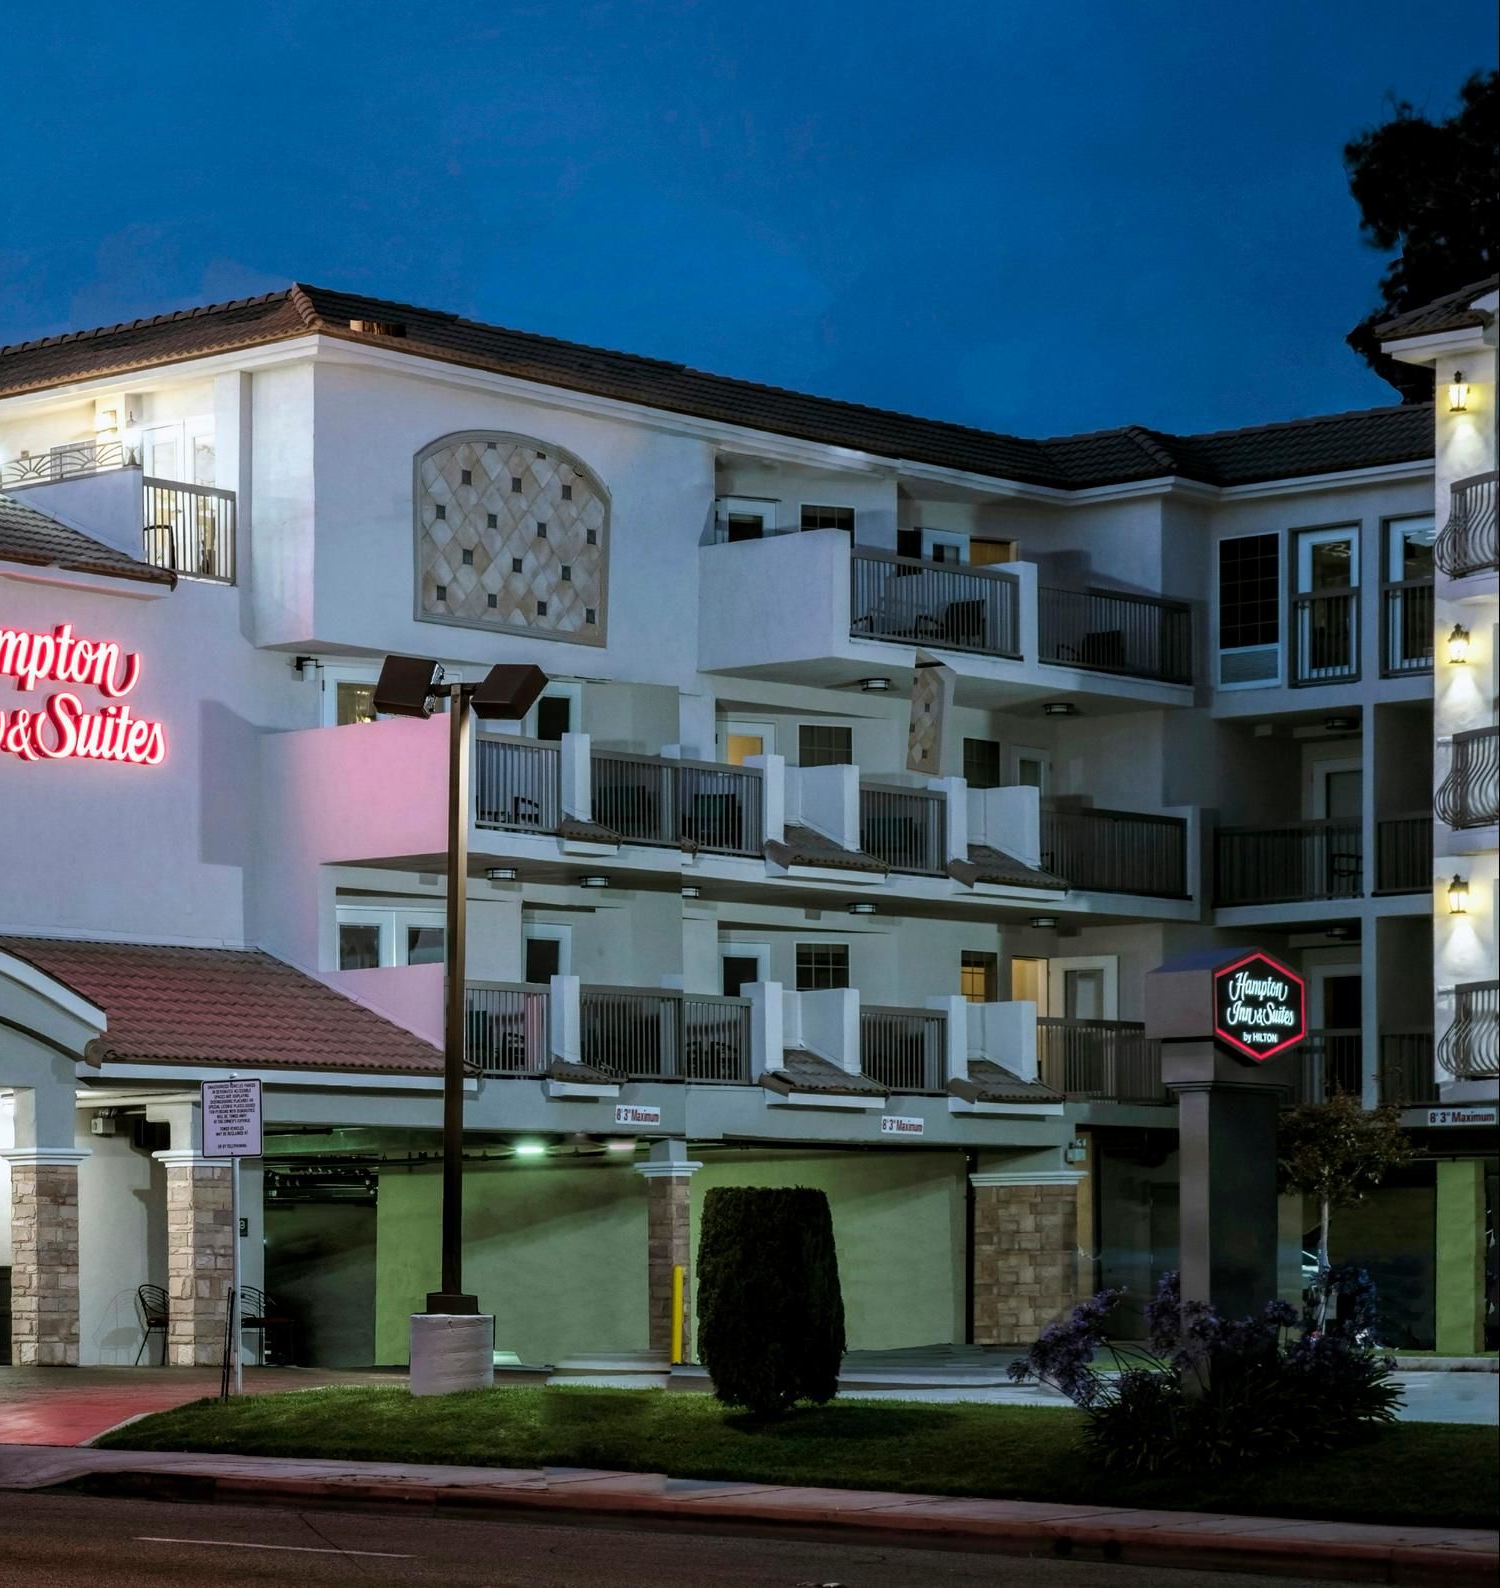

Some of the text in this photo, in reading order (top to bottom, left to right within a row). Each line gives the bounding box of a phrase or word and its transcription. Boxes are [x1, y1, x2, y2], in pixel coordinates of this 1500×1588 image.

[3, 708, 39, 761] &
[34, 692, 165, 764] Suites
[1229, 972, 1288, 1001] Hampton
[1227, 1001, 1294, 1026] Inn & Suites
[1243, 1032, 1278, 1043] by HILTON
[631, 1108, 659, 1122] Maximum
[1452, 1111, 1494, 1122] Maximum
[896, 1120, 922, 1132] Maximum
